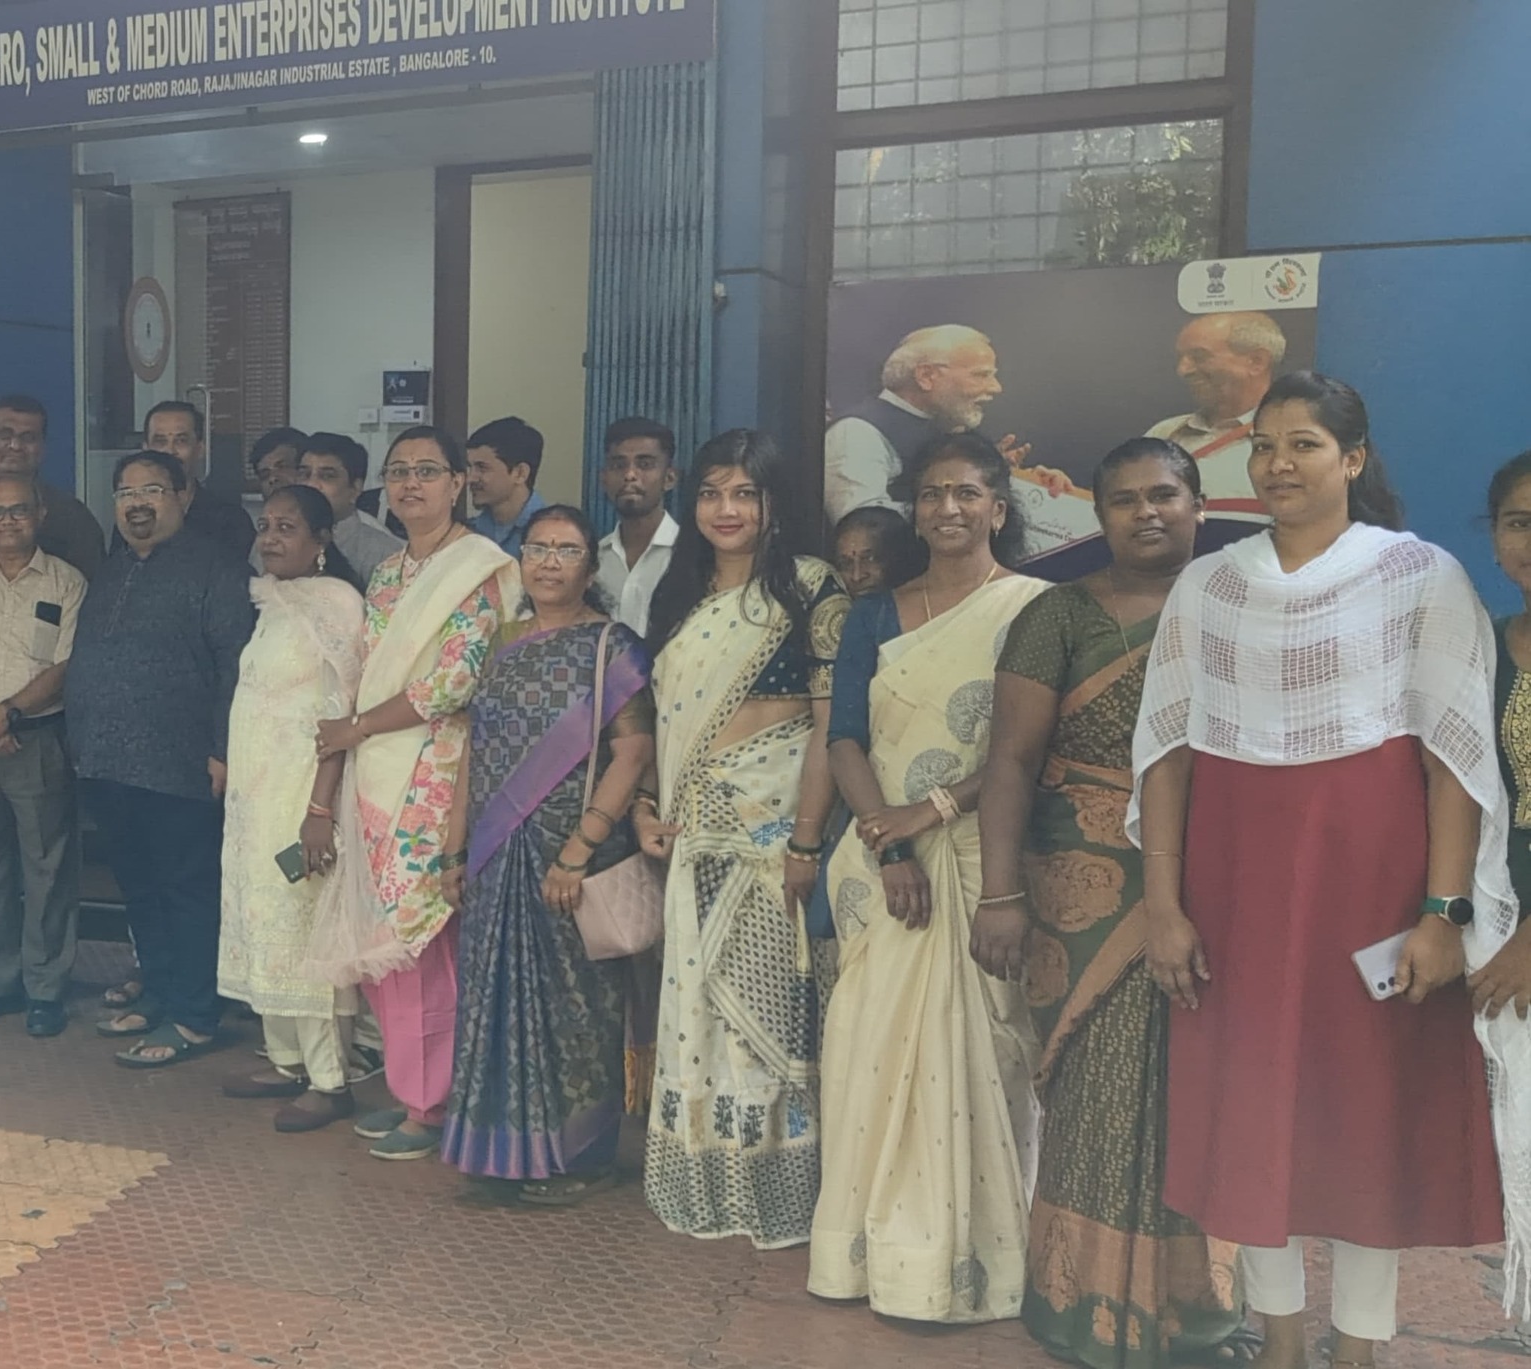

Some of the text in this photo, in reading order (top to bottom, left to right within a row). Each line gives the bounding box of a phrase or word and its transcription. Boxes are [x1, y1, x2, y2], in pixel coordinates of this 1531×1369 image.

[35, 21, 101, 83] SMALL
[105, 17, 120, 74] &
[125, 7, 208, 72] MEDIUM
[213, 0, 362, 62] ENTERPRISES
[86, 86, 116, 106] WEST
[117, 85, 131, 103] OF
[132, 81, 168, 101] CHORD
[170, 77, 202, 98] ROAD,
[203, 68, 277, 94] RAJAJINAGAR
[279, 60, 346, 86] INDUSTRIAL
[348, 56, 390, 78] ESTATE
[399, 48, 470, 73] BANGALORE
[478, 45, 497, 64] 10.
